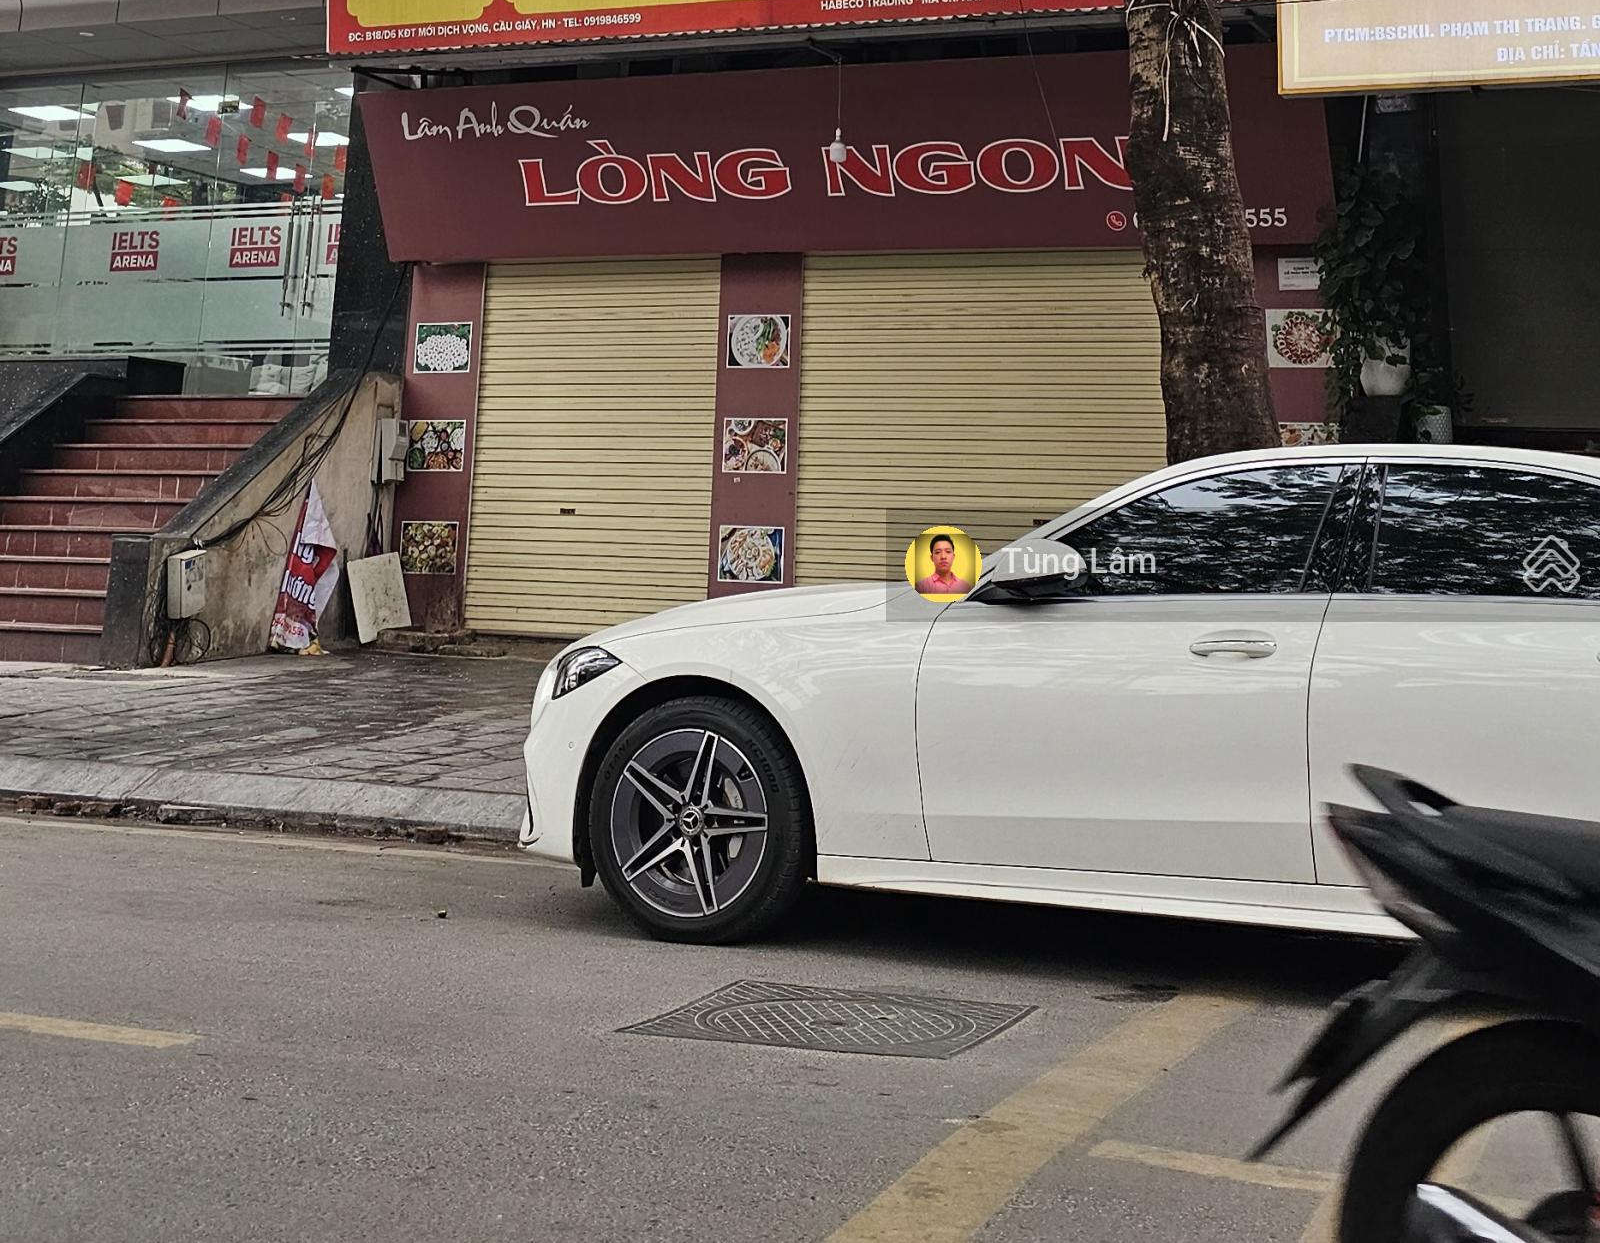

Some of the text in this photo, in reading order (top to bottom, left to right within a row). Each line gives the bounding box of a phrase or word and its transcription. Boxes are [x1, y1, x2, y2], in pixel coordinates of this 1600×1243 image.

[348, 32, 364, 42] ĐC:
[366, 29, 396, 40] B18/D6
[398, 27, 416, 38] KĐT
[418, 24, 436, 37] MỚI
[438, 24, 460, 37] DỊCH
[462, 22, 491, 35] VỌNG,
[541, 18, 556, 29] HN
[563, 16, 582, 28] TEL:
[583, 13, 641, 26] 0919846599
[1440, 21, 1489, 39] PHẠM
[1494, 19, 1520, 36] THỊ
[1525, 16, 1586, 32] TRANG.
[1497, 46, 1526, 64] ĐỊA
[1531, 39, 1565, 60] CHỈ:
[401, 101, 590, 143] Lâm Anh Quán
[518, 136, 1134, 207] LÒNG NGON
[112, 230, 160, 251] IELTS
[231, 225, 282, 247] IELTS
[112, 254, 154, 269] ARENA
[232, 249, 277, 264] ARENA
